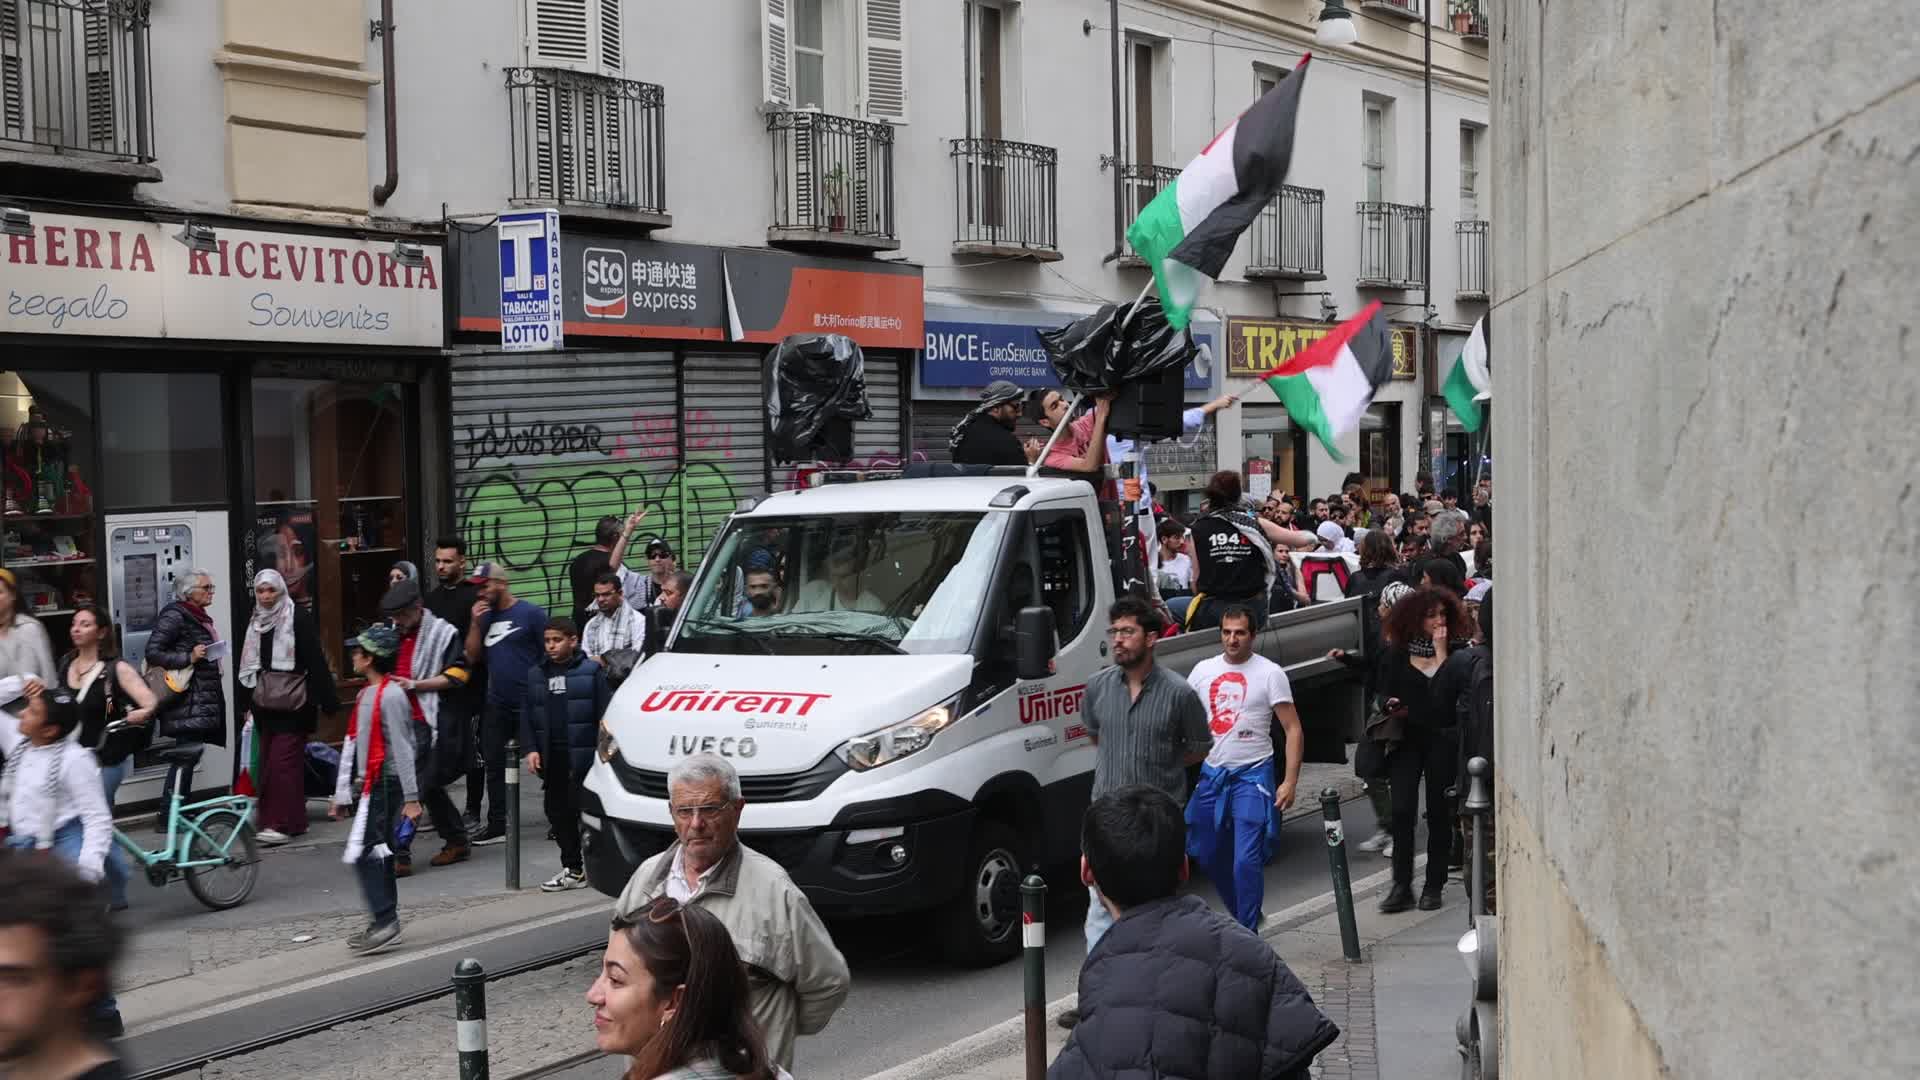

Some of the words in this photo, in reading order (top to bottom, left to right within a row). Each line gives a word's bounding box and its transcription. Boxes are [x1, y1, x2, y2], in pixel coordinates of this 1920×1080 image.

[0, 224, 155, 273] HERIA
[188, 239, 438, 290] RICEVITORIA
[587, 255, 624, 286] sto
[551, 215, 561, 337] TABACCHI
[631, 259, 696, 290] 申通快递
[8, 283, 128, 329] regalo
[248, 292, 390, 331] Souvenirs
[503, 300, 549, 315] TABACCHI
[632, 290, 697, 313] express
[504, 324, 549, 343] LOTTO
[926, 333, 979, 360] BMCE
[989, 366, 1013, 376] GRUPPO
[1014, 367, 1030, 376] BMCE
[1031, 367, 1047, 377] BANK
[668, 735, 757, 758] IVECO
